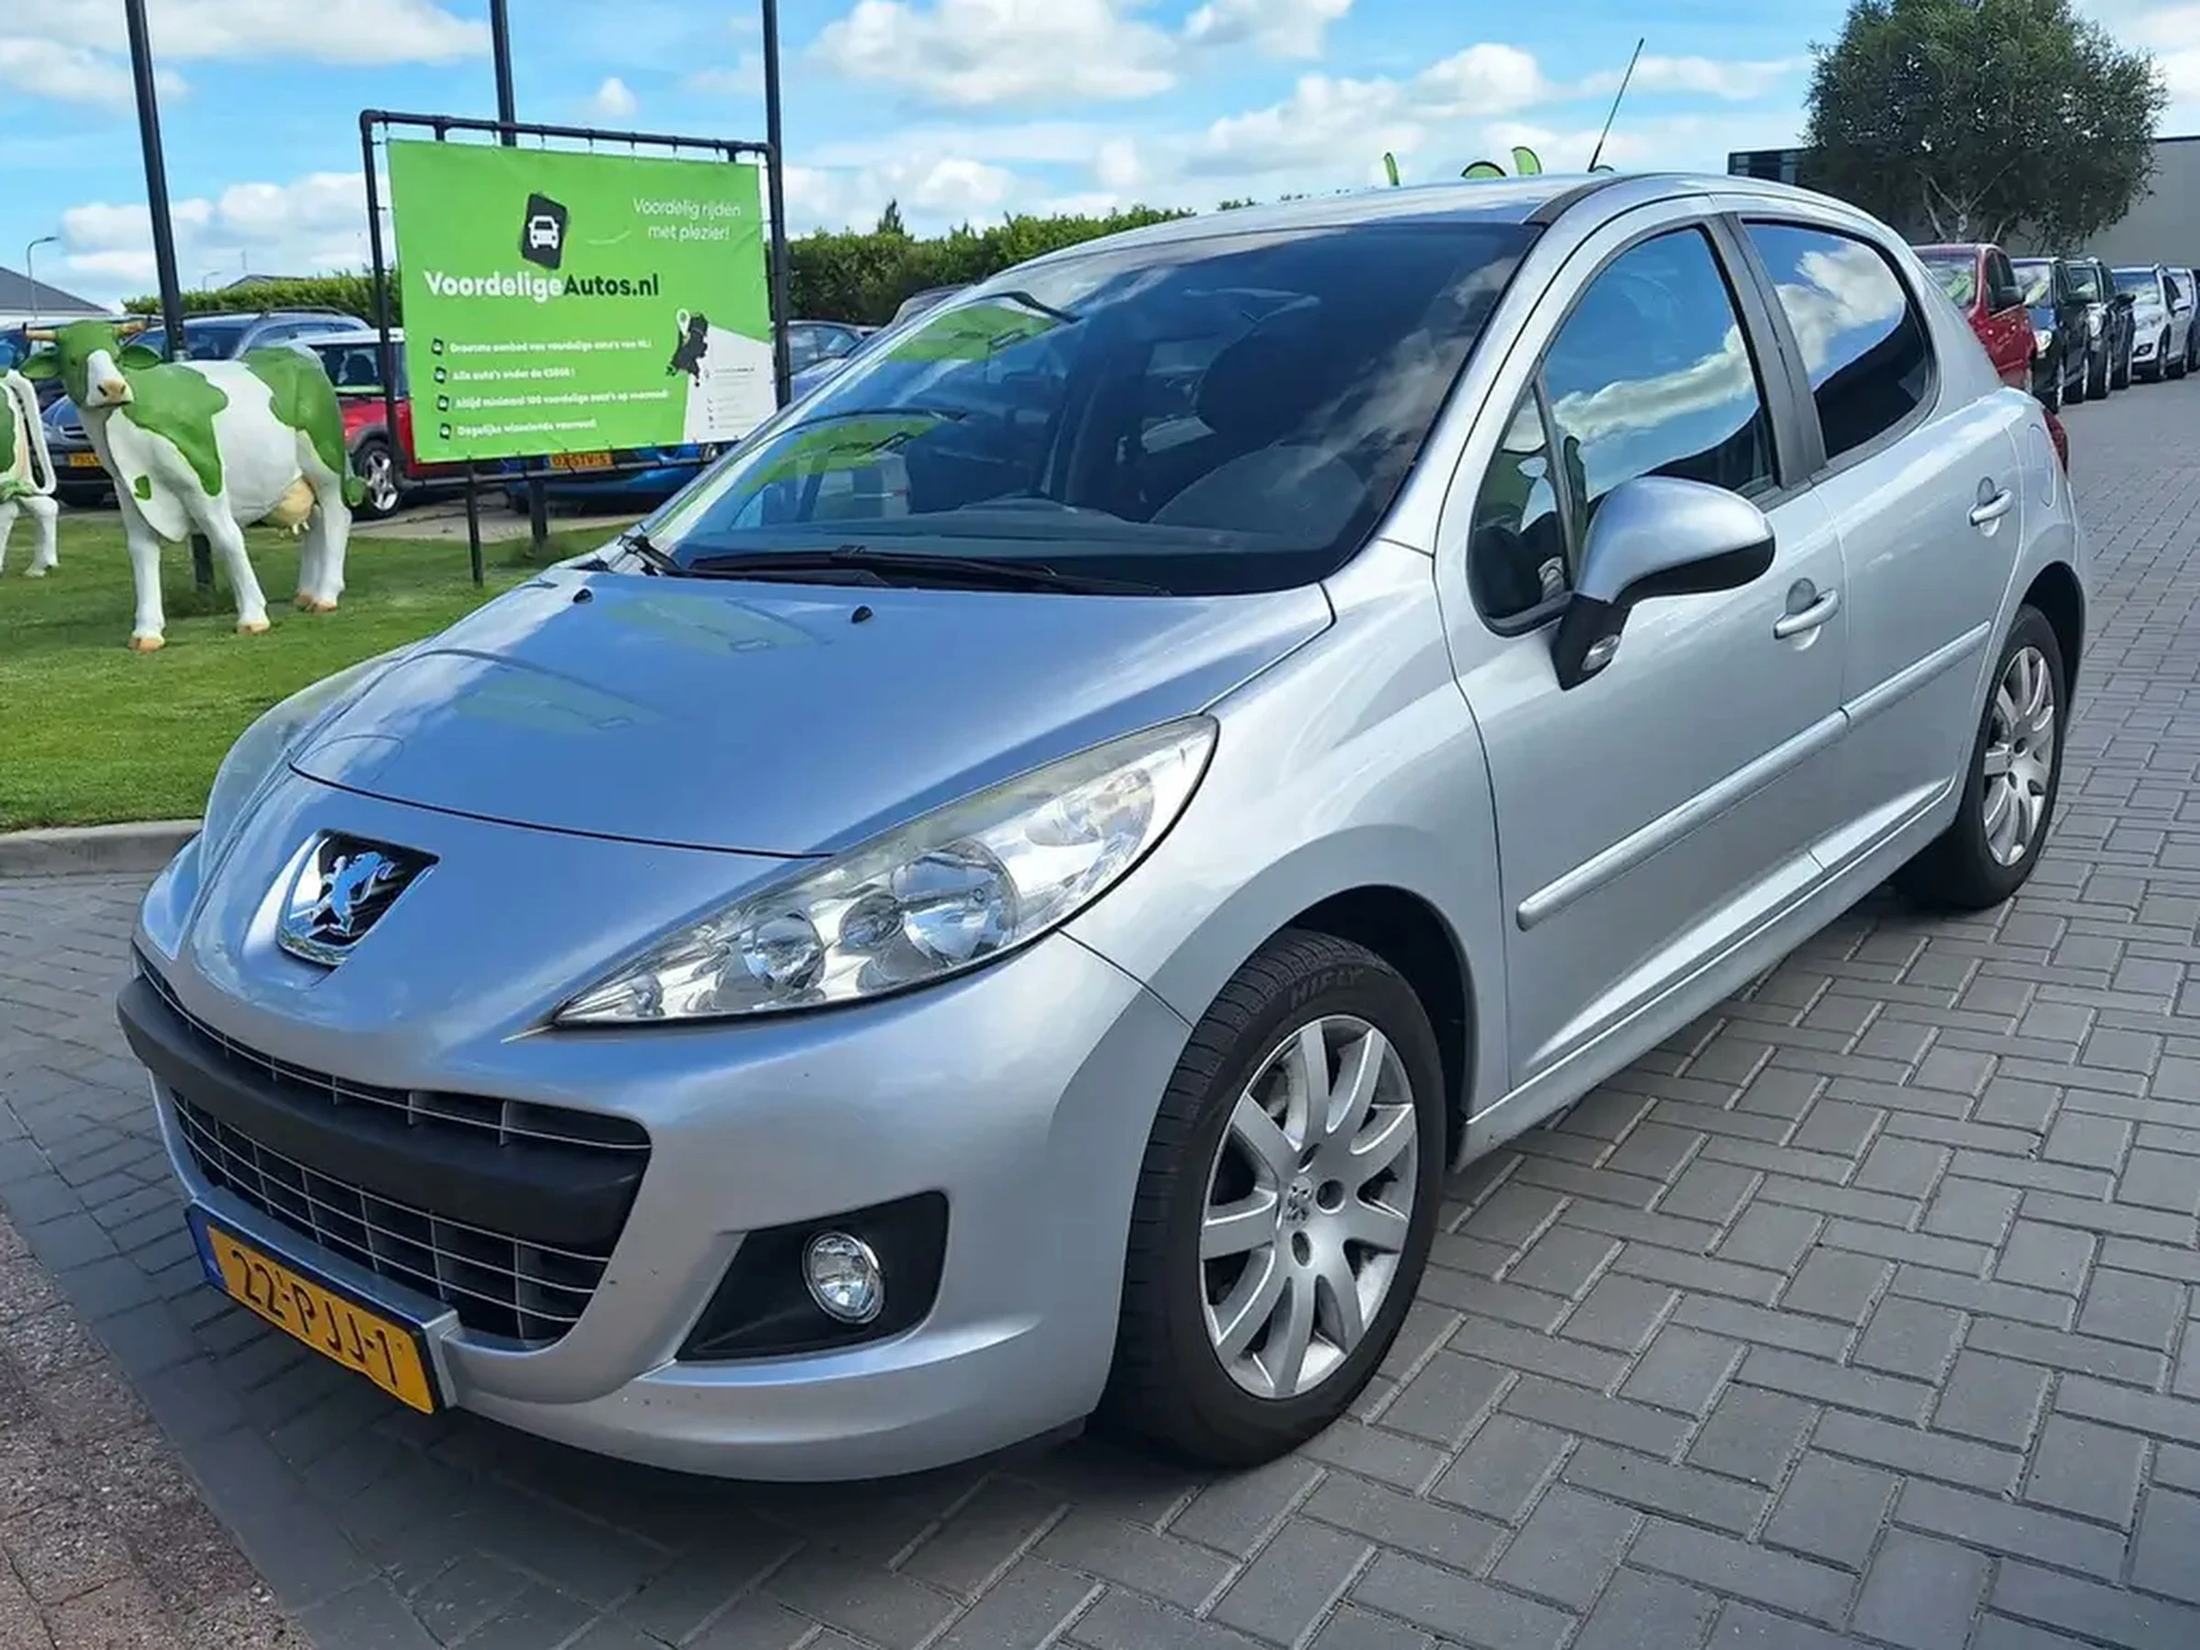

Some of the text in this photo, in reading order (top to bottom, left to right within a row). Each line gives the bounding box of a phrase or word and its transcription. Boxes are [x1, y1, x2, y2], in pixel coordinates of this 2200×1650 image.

[632, 197, 741, 221] Voordelig rijden
[648, 225, 677, 239] met
[423, 270, 660, 303] VoordeligeAutos.nl
[453, 370, 471, 380] Alle
[472, 369, 501, 380] auto's
[230, 1249, 399, 1389] 22-PJJ-1
